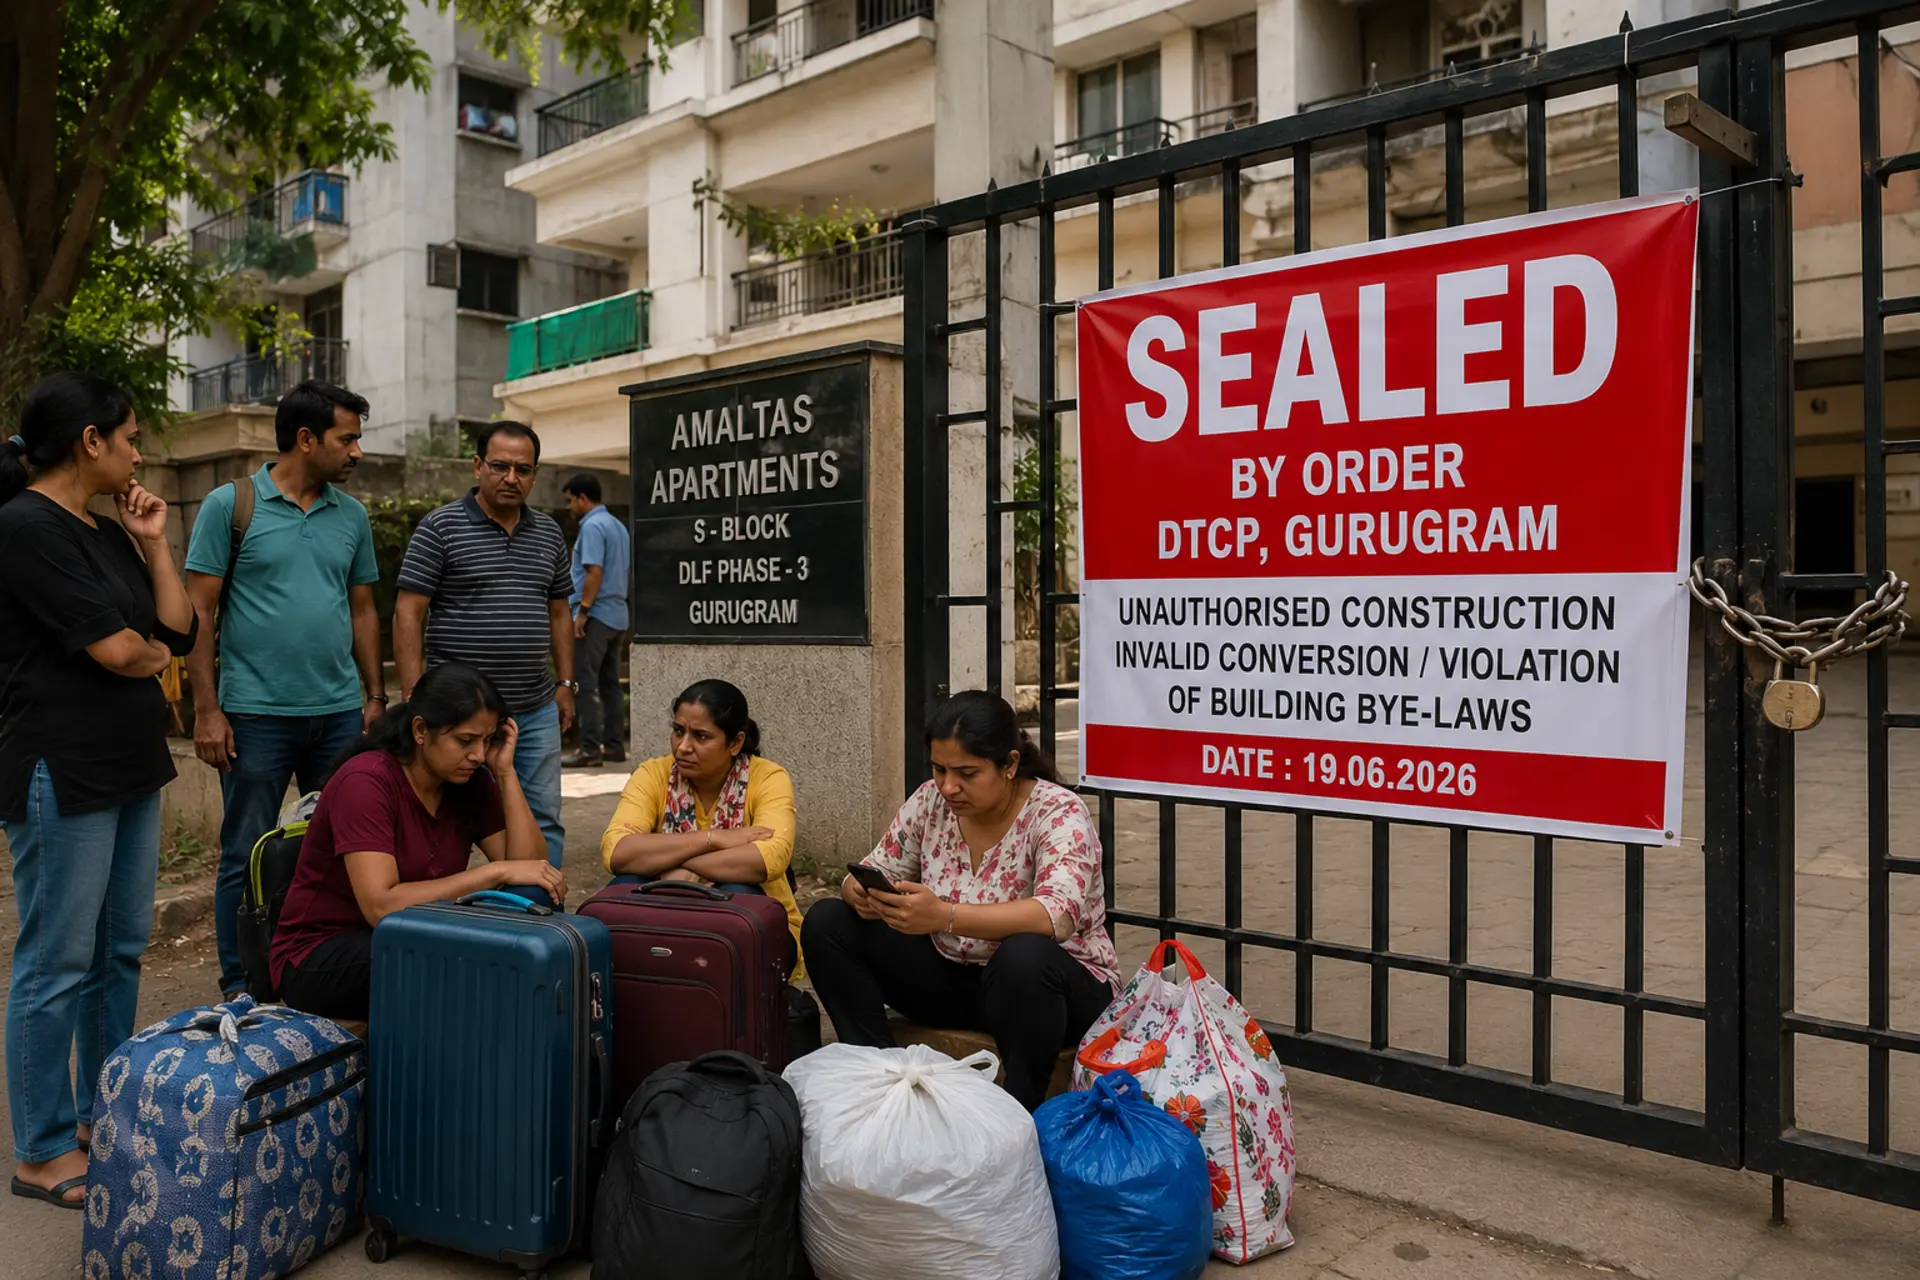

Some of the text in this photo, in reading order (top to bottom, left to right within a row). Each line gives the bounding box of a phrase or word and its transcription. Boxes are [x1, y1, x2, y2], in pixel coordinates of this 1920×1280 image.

[1125, 254, 1618, 442] SEALED
[672, 395, 812, 449] AMALTAS
[651, 450, 838, 504] APARTMENTS
[1232, 443, 1465, 498] BY ORDER
[1159, 505, 1557, 564] DTCP, GURUGRAM
[680, 561, 712, 584] DLF
[719, 557, 780, 583] PHASE
[798, 556, 808, 580] 3
[690, 600, 797, 624] GURUGRAM
[1120, 596, 1614, 630] UNAUTHORISED CONSTRUCTION
[1116, 641, 1619, 683] INVALID CONVERSION / VIOLATION
[1169, 685, 1531, 732] OF BUILDING BYE-LAWS
[1203, 745, 1273, 778] DATE
[1303, 752, 1477, 797] 19.06.2026
